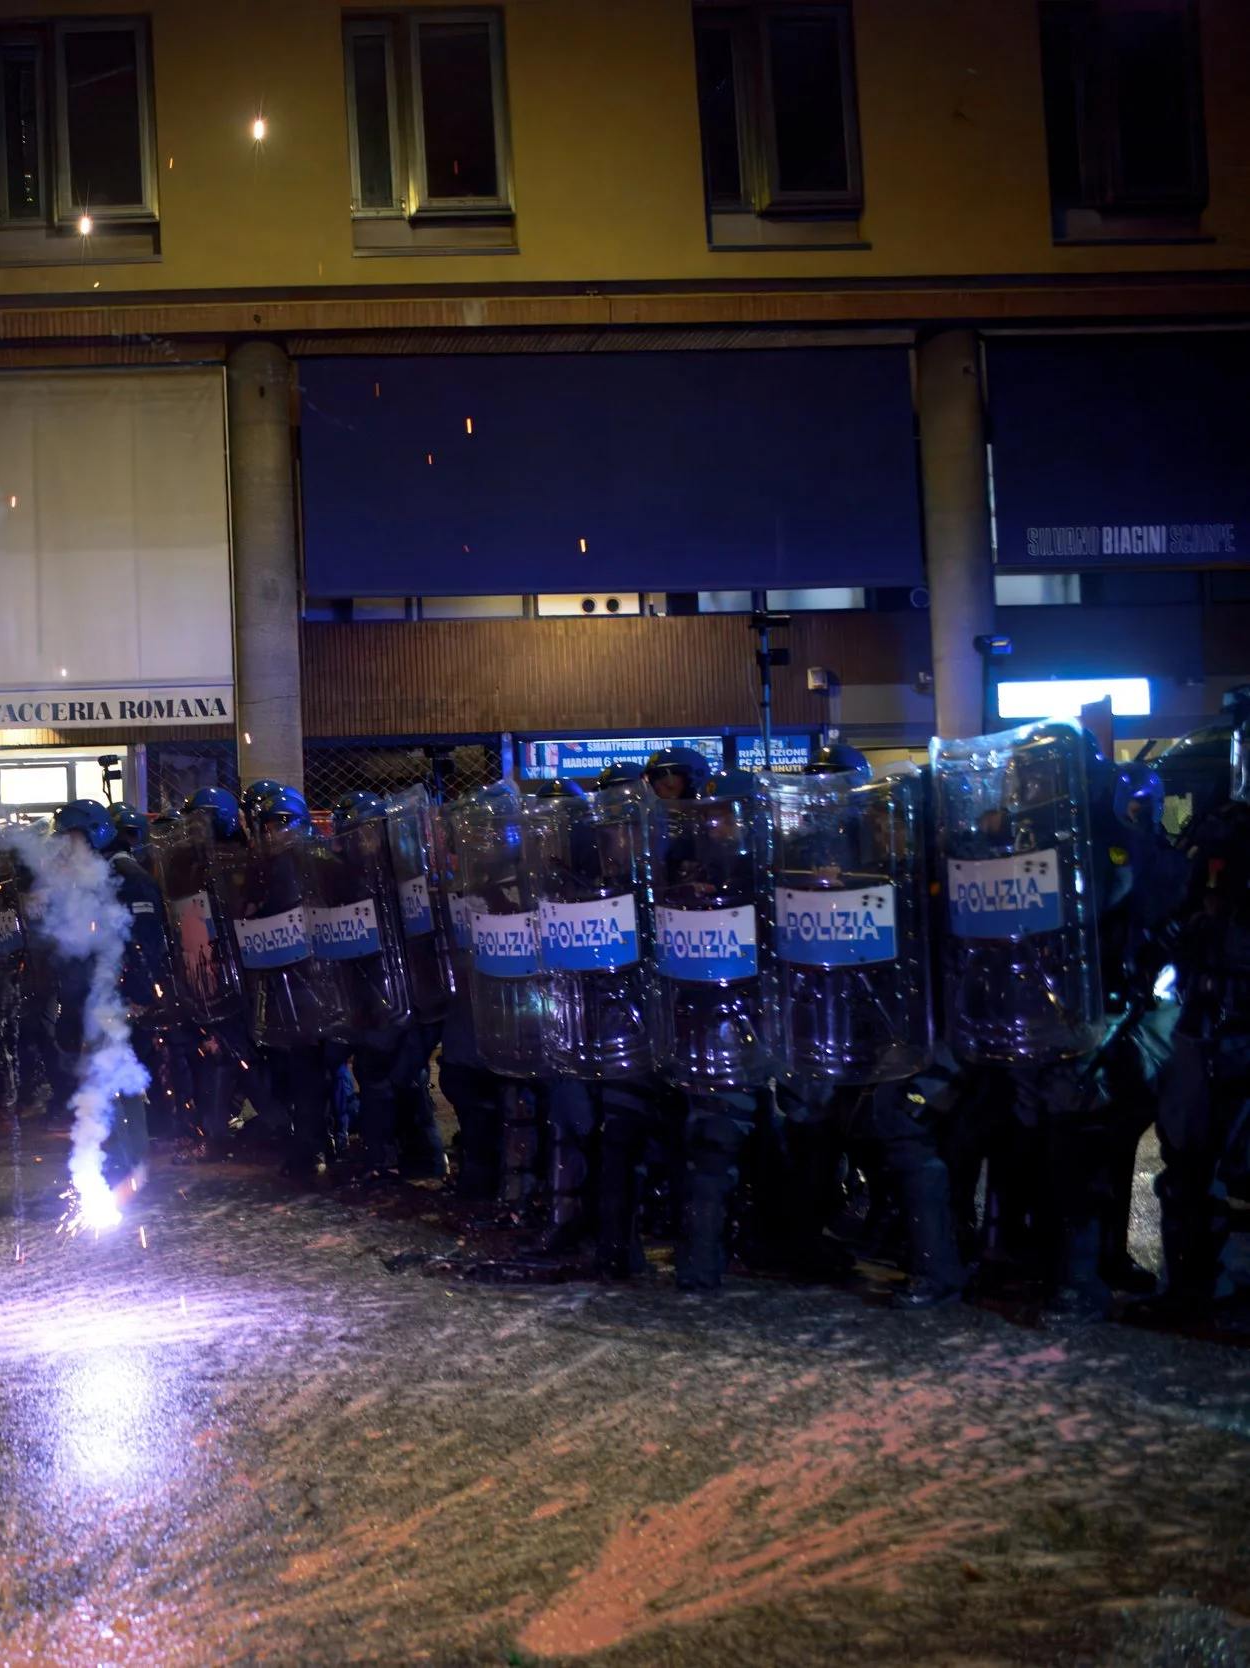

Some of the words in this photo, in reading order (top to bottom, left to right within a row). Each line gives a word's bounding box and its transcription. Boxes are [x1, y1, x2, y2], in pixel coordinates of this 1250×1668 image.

[1102, 525, 1167, 555] BIAGINI
[119, 697, 227, 720] ROMANA
[587, 741, 646, 752] SMARTPHONE
[562, 757, 603, 768] MARCONI
[603, 757, 611, 767] 6
[739, 758, 752, 766] PC
[754, 756, 808, 766] CELULARI
[956, 877, 1045, 914] POLIZIA
[244, 924, 305, 954] POLIZIA
[313, 918, 369, 944] POLIZIA
[548, 917, 624, 949] POLIZIA
[786, 911, 881, 941] POLIZIA
[477, 931, 535, 957] POLIZIA
[663, 930, 742, 959] POLIZIA
